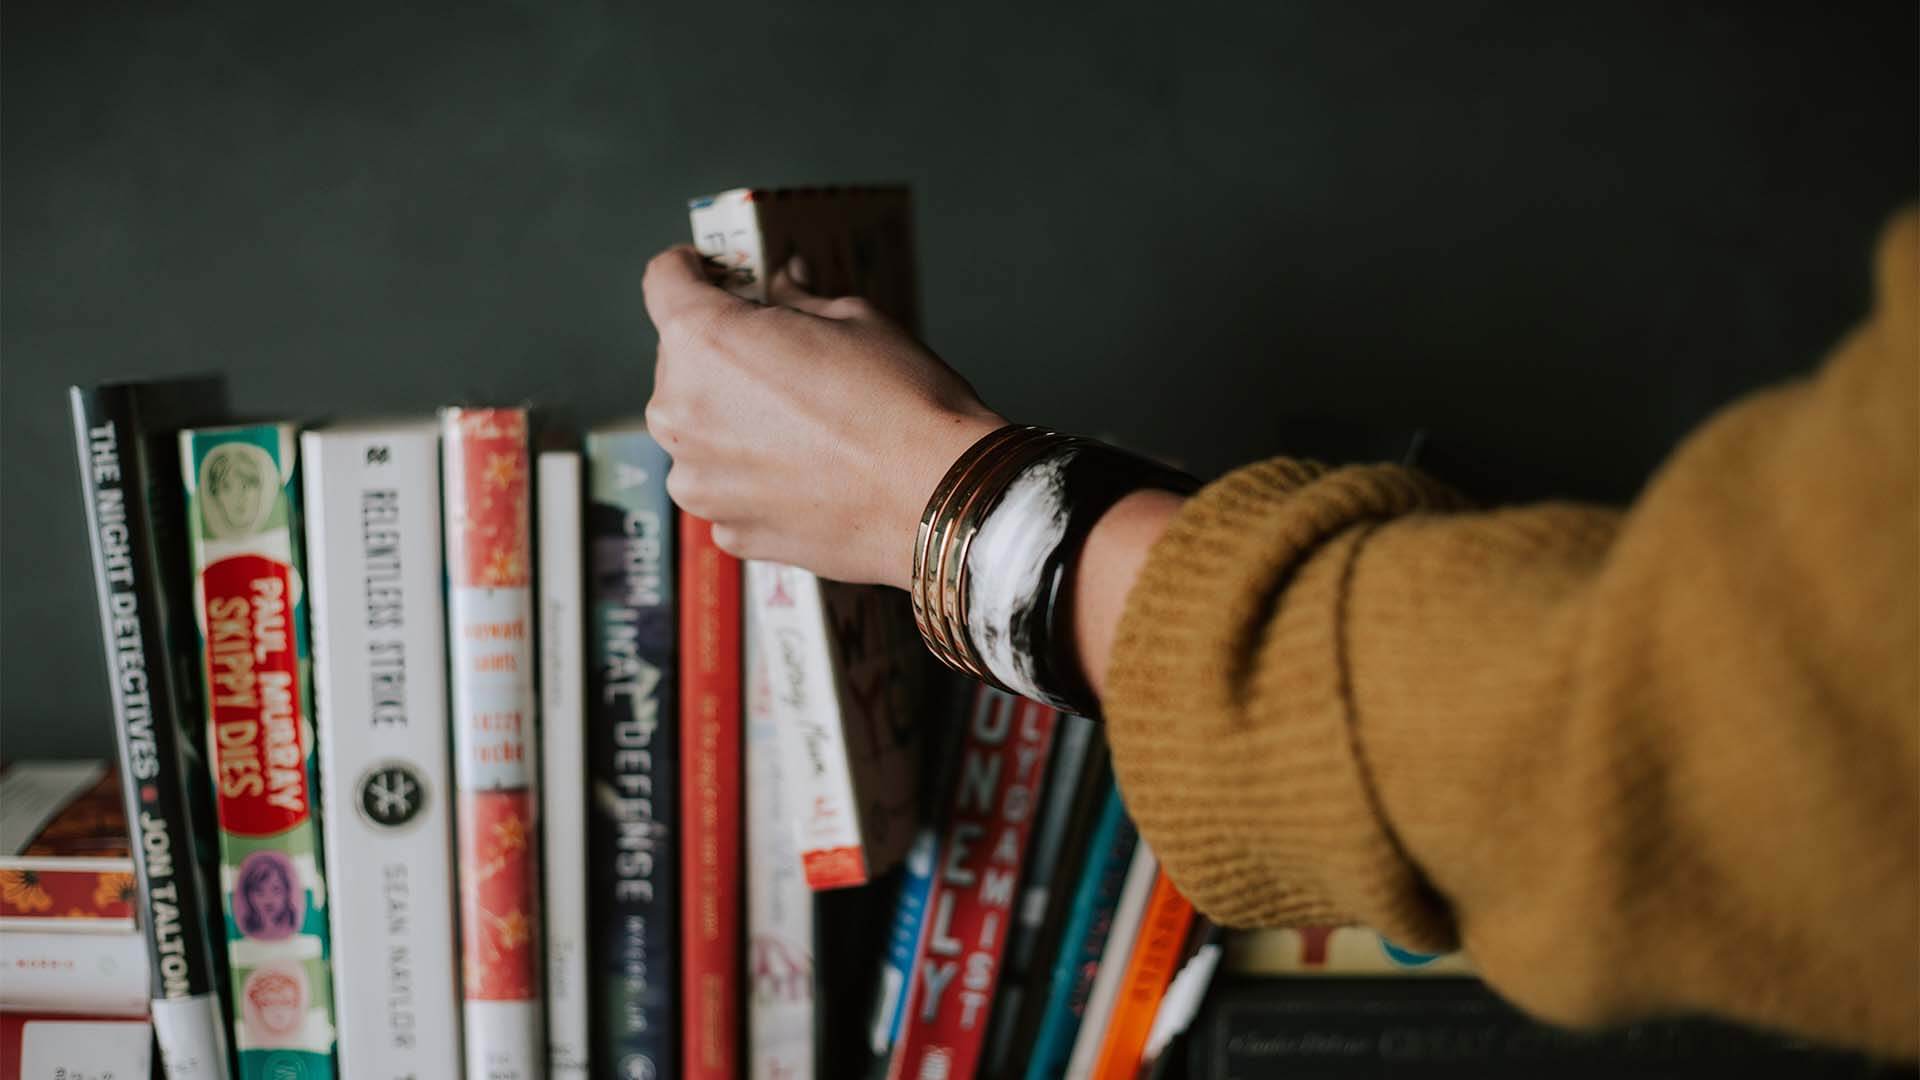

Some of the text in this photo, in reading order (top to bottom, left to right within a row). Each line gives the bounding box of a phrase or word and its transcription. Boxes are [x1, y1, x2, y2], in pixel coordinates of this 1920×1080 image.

[90, 420, 160, 780] THE NIGHT DETECTIVES
[207, 594, 265, 799] SKIPPY DIES
[250, 577, 304, 813] PAUL MURRAY
[361, 490, 407, 729] RELENTLESS STRIKE
[141, 811, 192, 1000] JON TALTON
[383, 862, 411, 935] SEAN
[613, 721, 654, 902] DEFENSE
[920, 685, 1018, 1024] ONELY
[959, 699, 1044, 1030] LYGAMIST
[388, 945, 417, 1050] NAYLOR
